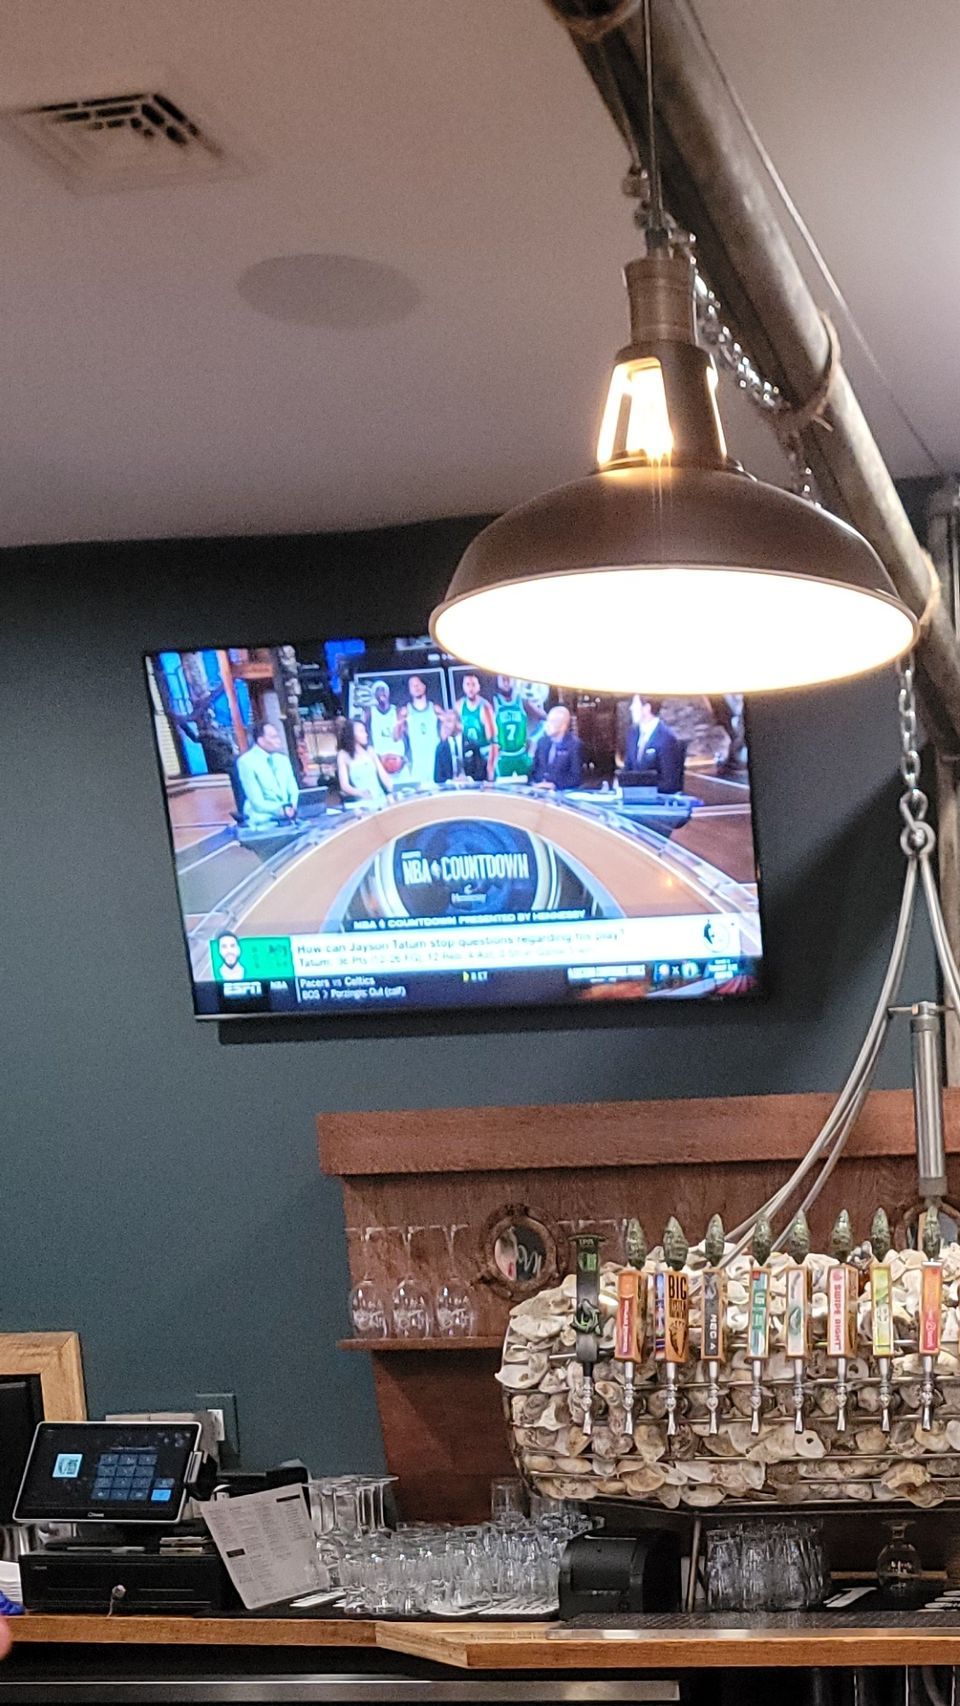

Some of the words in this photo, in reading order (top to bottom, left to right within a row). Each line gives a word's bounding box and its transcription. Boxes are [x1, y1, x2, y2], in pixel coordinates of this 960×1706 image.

[506, 724, 516, 741] 7
[402, 858, 432, 885] NBA
[441, 852, 530, 880] COUNTDOWN
[354, 920, 377, 929] NBA
[387, 916, 457, 928] COUNTDOWN
[457, 913, 517, 924] PRESENTED
[517, 912, 531, 922] BY
[532, 909, 586, 921] HENNESSY
[297, 944, 322, 955] How
[326, 945, 346, 954] can
[350, 941, 389, 953] Jayson
[392, 939, 427, 950] Tatum
[430, 938, 454, 949] stop
[458, 935, 515, 948] questions
[222, 981, 262, 996] ESPN
[299, 978, 331, 989] Pacers
[331, 978, 342, 987] vs
[344, 976, 376, 987] Celtics
[302, 989, 320, 1000] BOS
[667, 1274, 688, 1300] BIG
[833, 1284, 843, 1315] SWIPE
[833, 1318, 844, 1351] RIGHT
